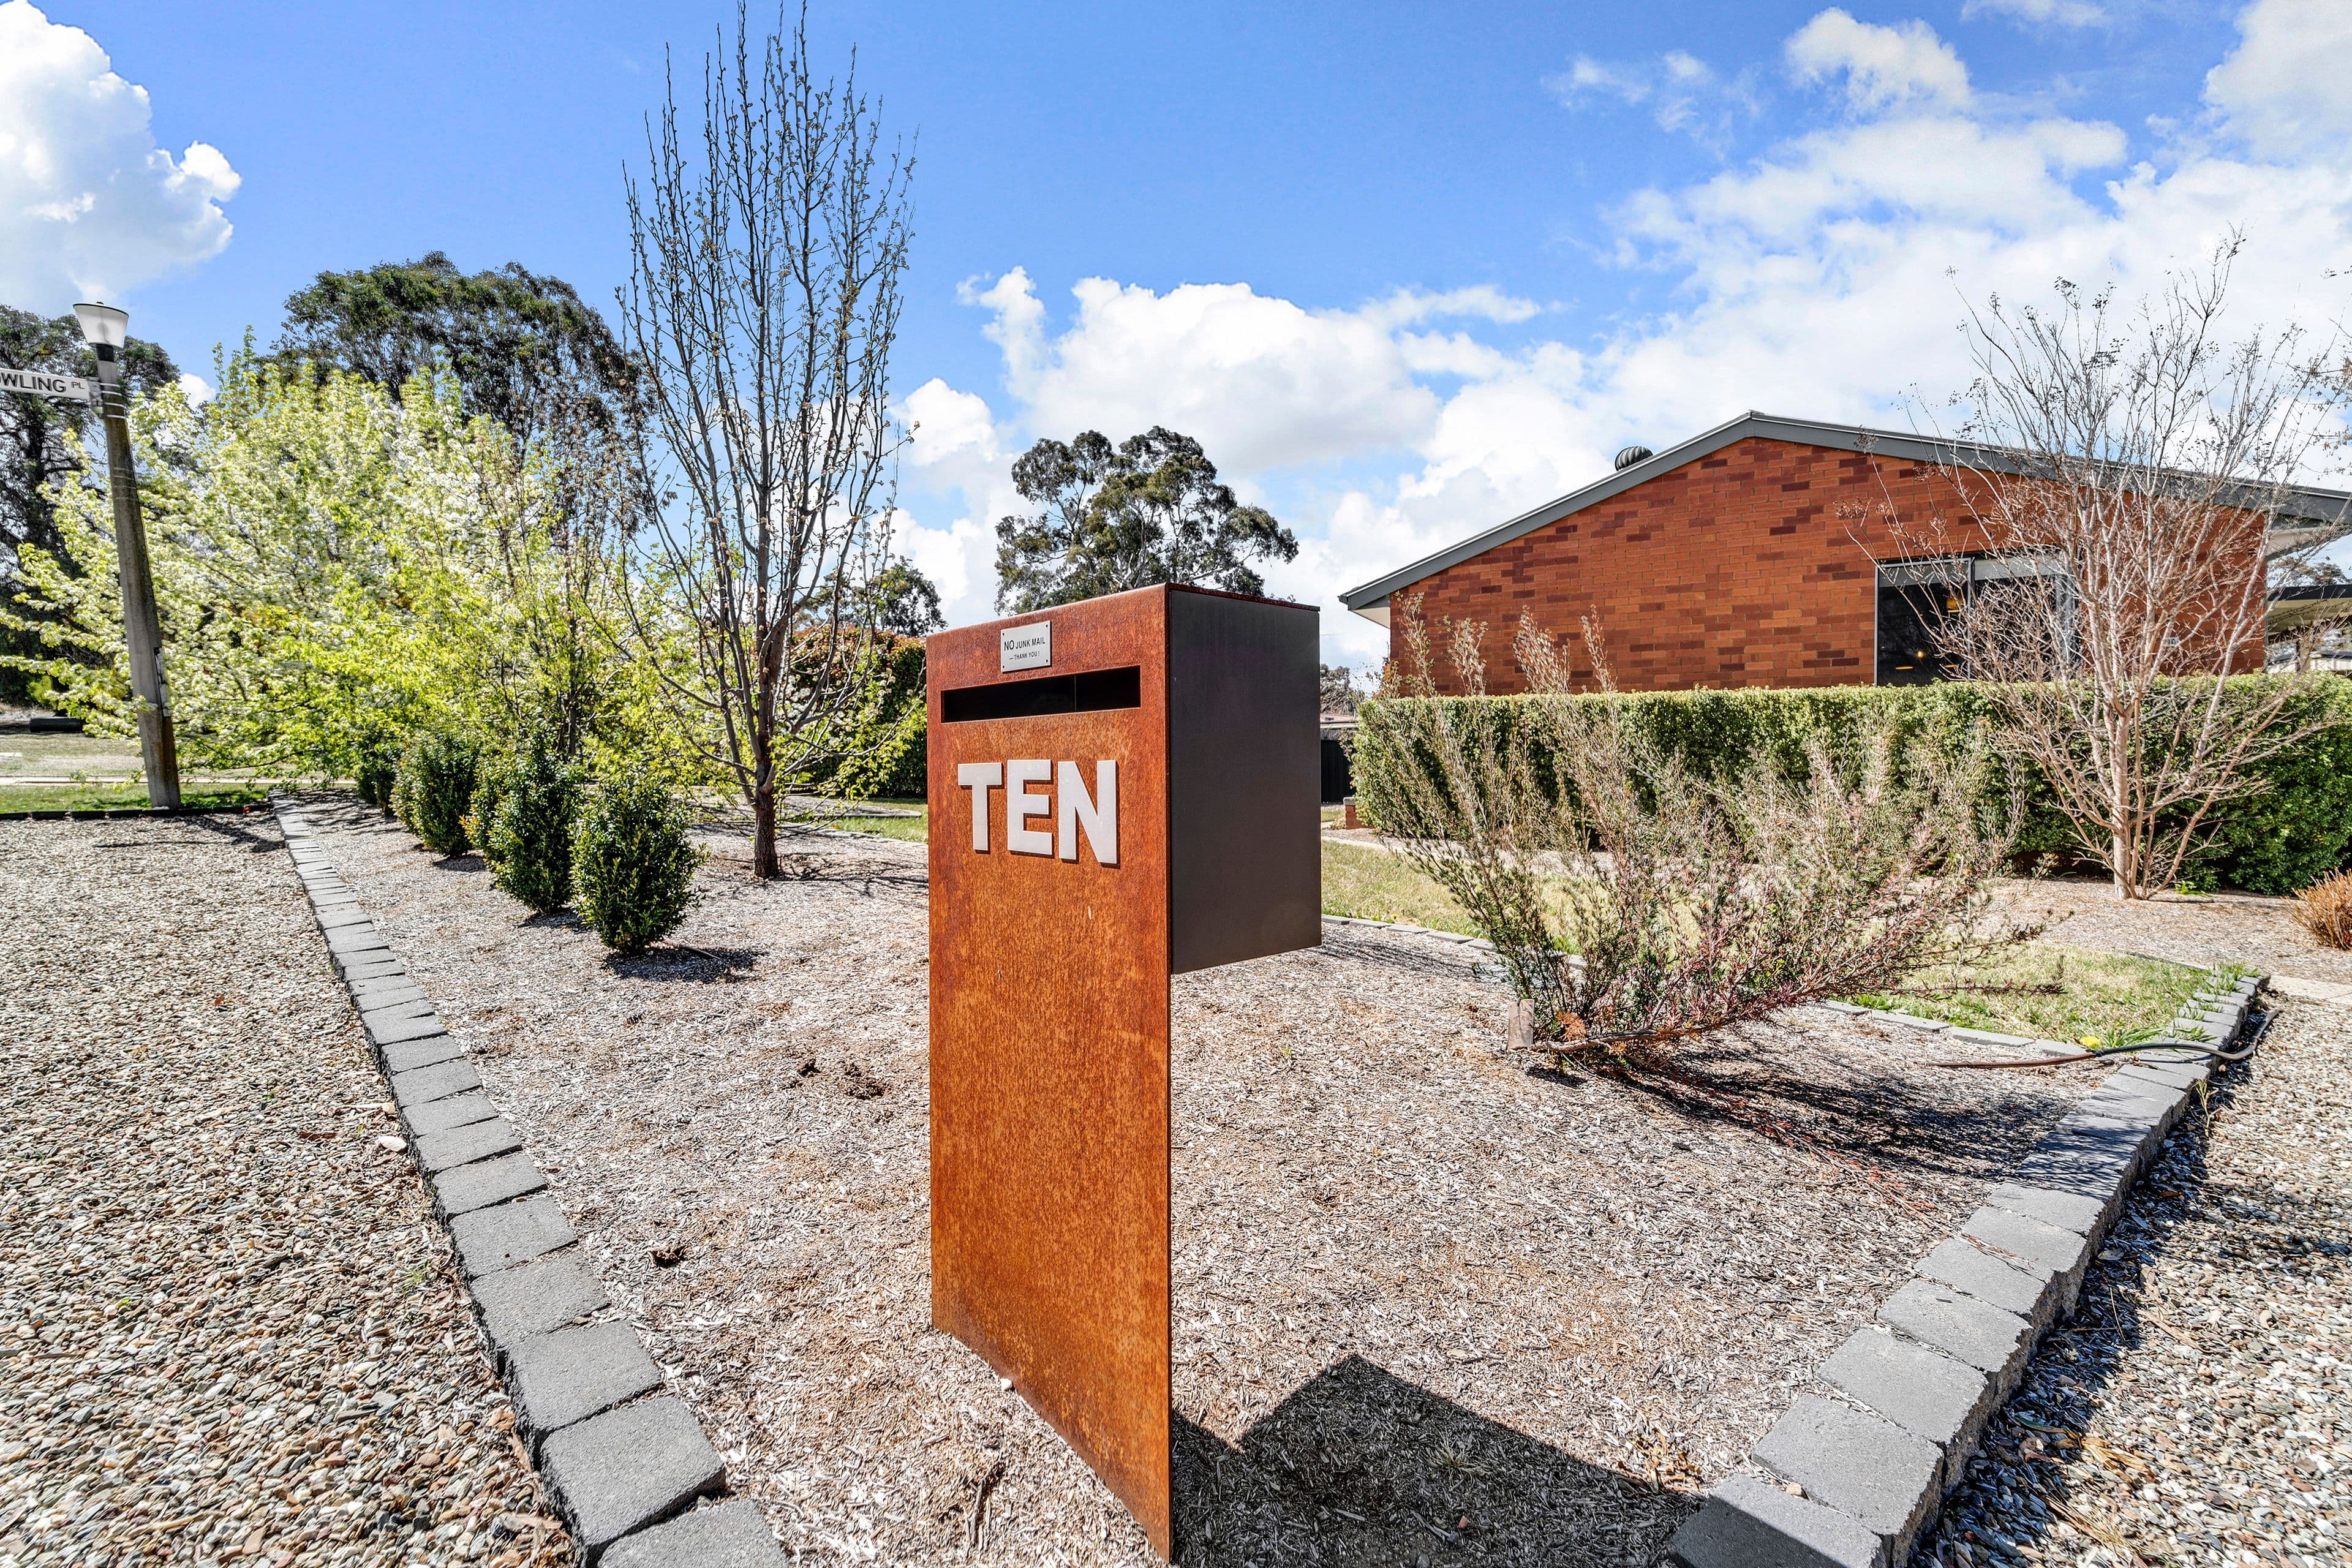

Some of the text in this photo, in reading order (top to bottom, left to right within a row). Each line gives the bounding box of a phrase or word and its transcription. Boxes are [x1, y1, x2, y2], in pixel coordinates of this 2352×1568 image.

[0, 372, 85, 393] WLING PL
[1004, 637, 1046, 651] NO JUNK MAIL
[958, 759, 1117, 864] TEN
